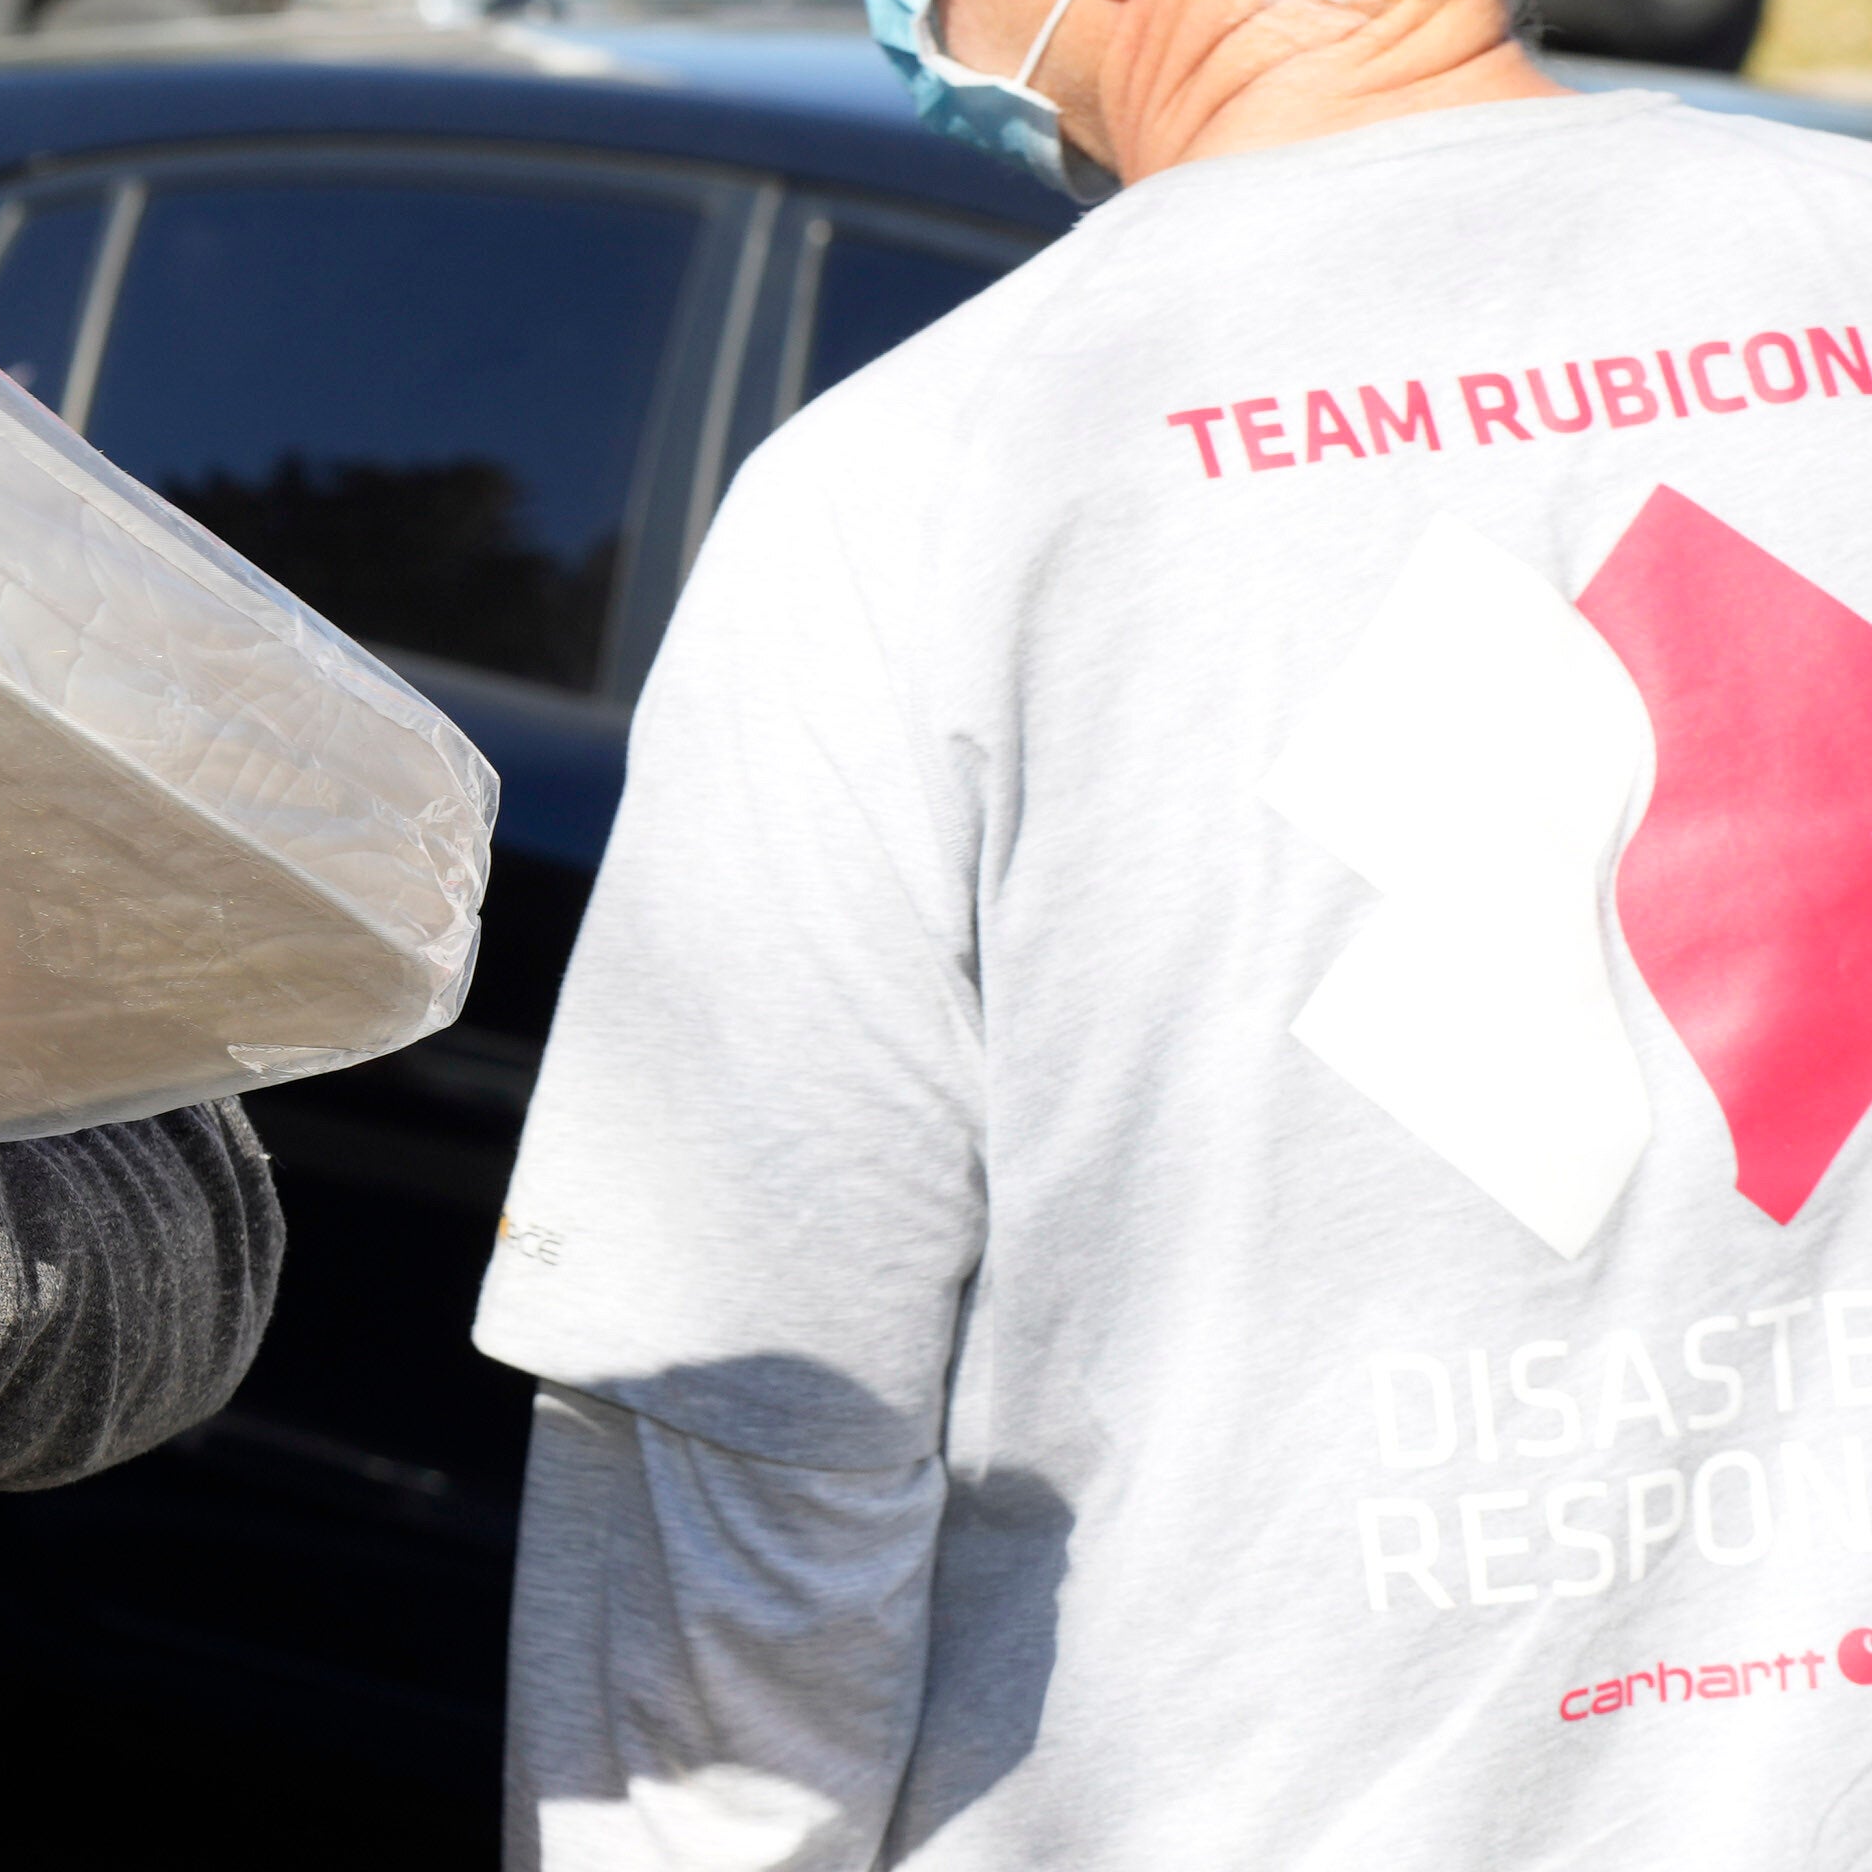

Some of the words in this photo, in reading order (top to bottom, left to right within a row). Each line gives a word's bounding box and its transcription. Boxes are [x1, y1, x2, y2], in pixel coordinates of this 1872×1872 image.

[1166, 380, 1443, 479] TEAM
[1457, 326, 1872, 446] RUBICON
[1559, 1649, 1825, 1722] carhartt
